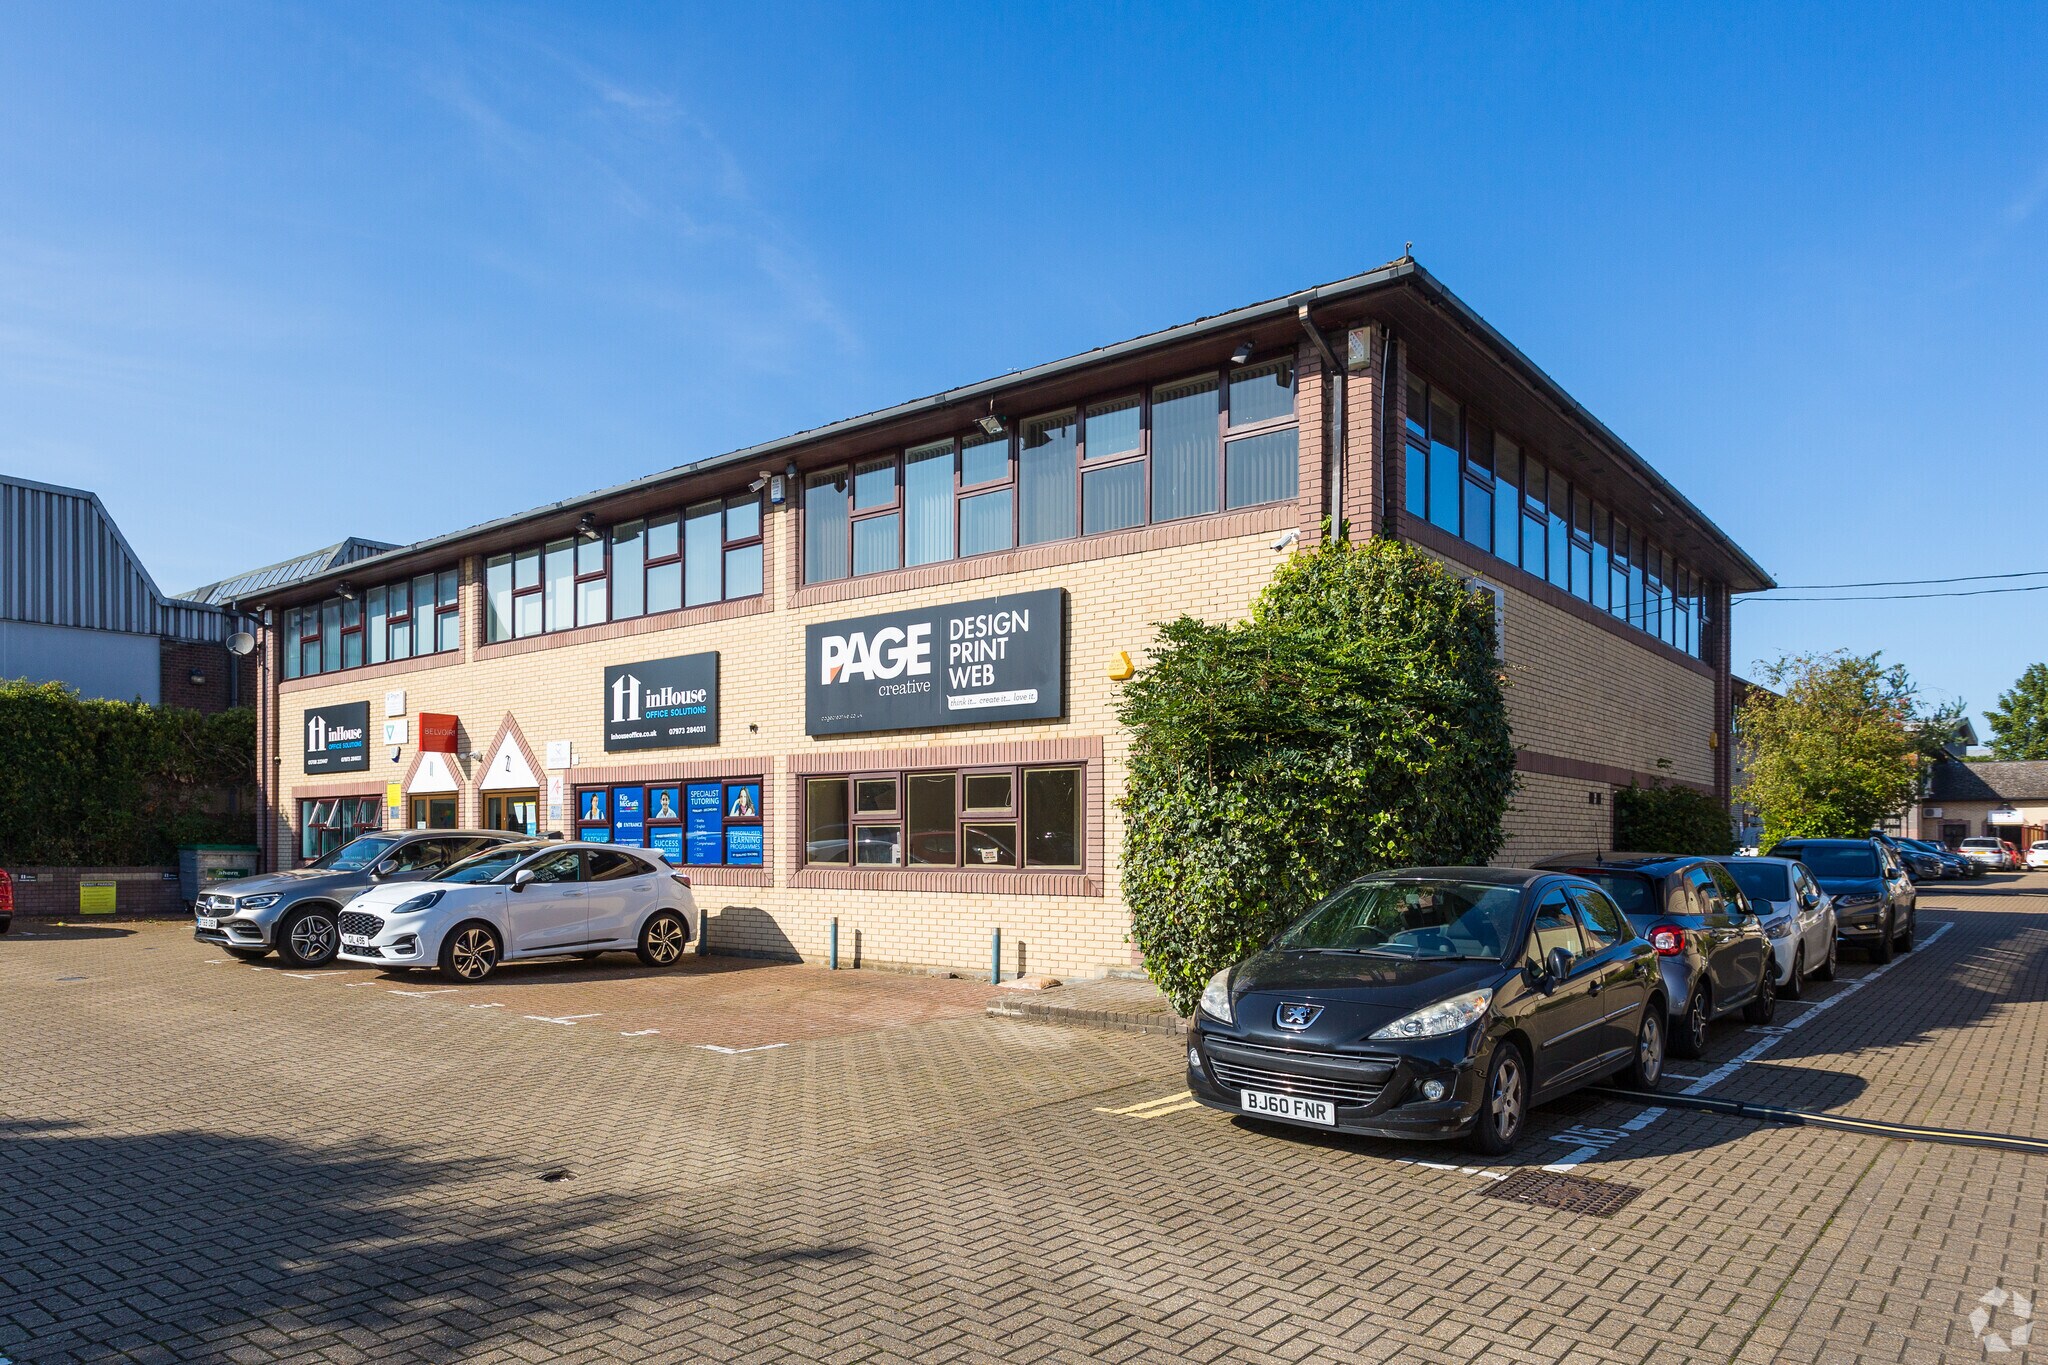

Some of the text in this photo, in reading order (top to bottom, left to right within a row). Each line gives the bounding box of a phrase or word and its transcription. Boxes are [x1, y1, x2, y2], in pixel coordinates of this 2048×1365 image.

[950, 609, 1029, 641] DESIGN
[821, 622, 932, 686] PAGE
[949, 637, 1009, 665] PRINT
[948, 664, 995, 690] WEB
[878, 679, 931, 697] creative
[645, 686, 707, 708] inHouse
[950, 697, 967, 707] think
[979, 696, 1000, 704] create
[1013, 693, 1027, 701] love
[645, 705, 707, 719] OFFICE SOLUTIONS
[328, 726, 362, 742] inHouse
[668, 726, 686, 735] 07973
[686, 725, 706, 734] 284031
[342, 741, 362, 749] SOLUTIONS
[690, 790, 719, 798] SPECIALIST
[690, 797, 720, 806] TUTORING
[730, 836, 761, 844] LEARNING
[1247, 1093, 1326, 1120] BJ60 FNR
